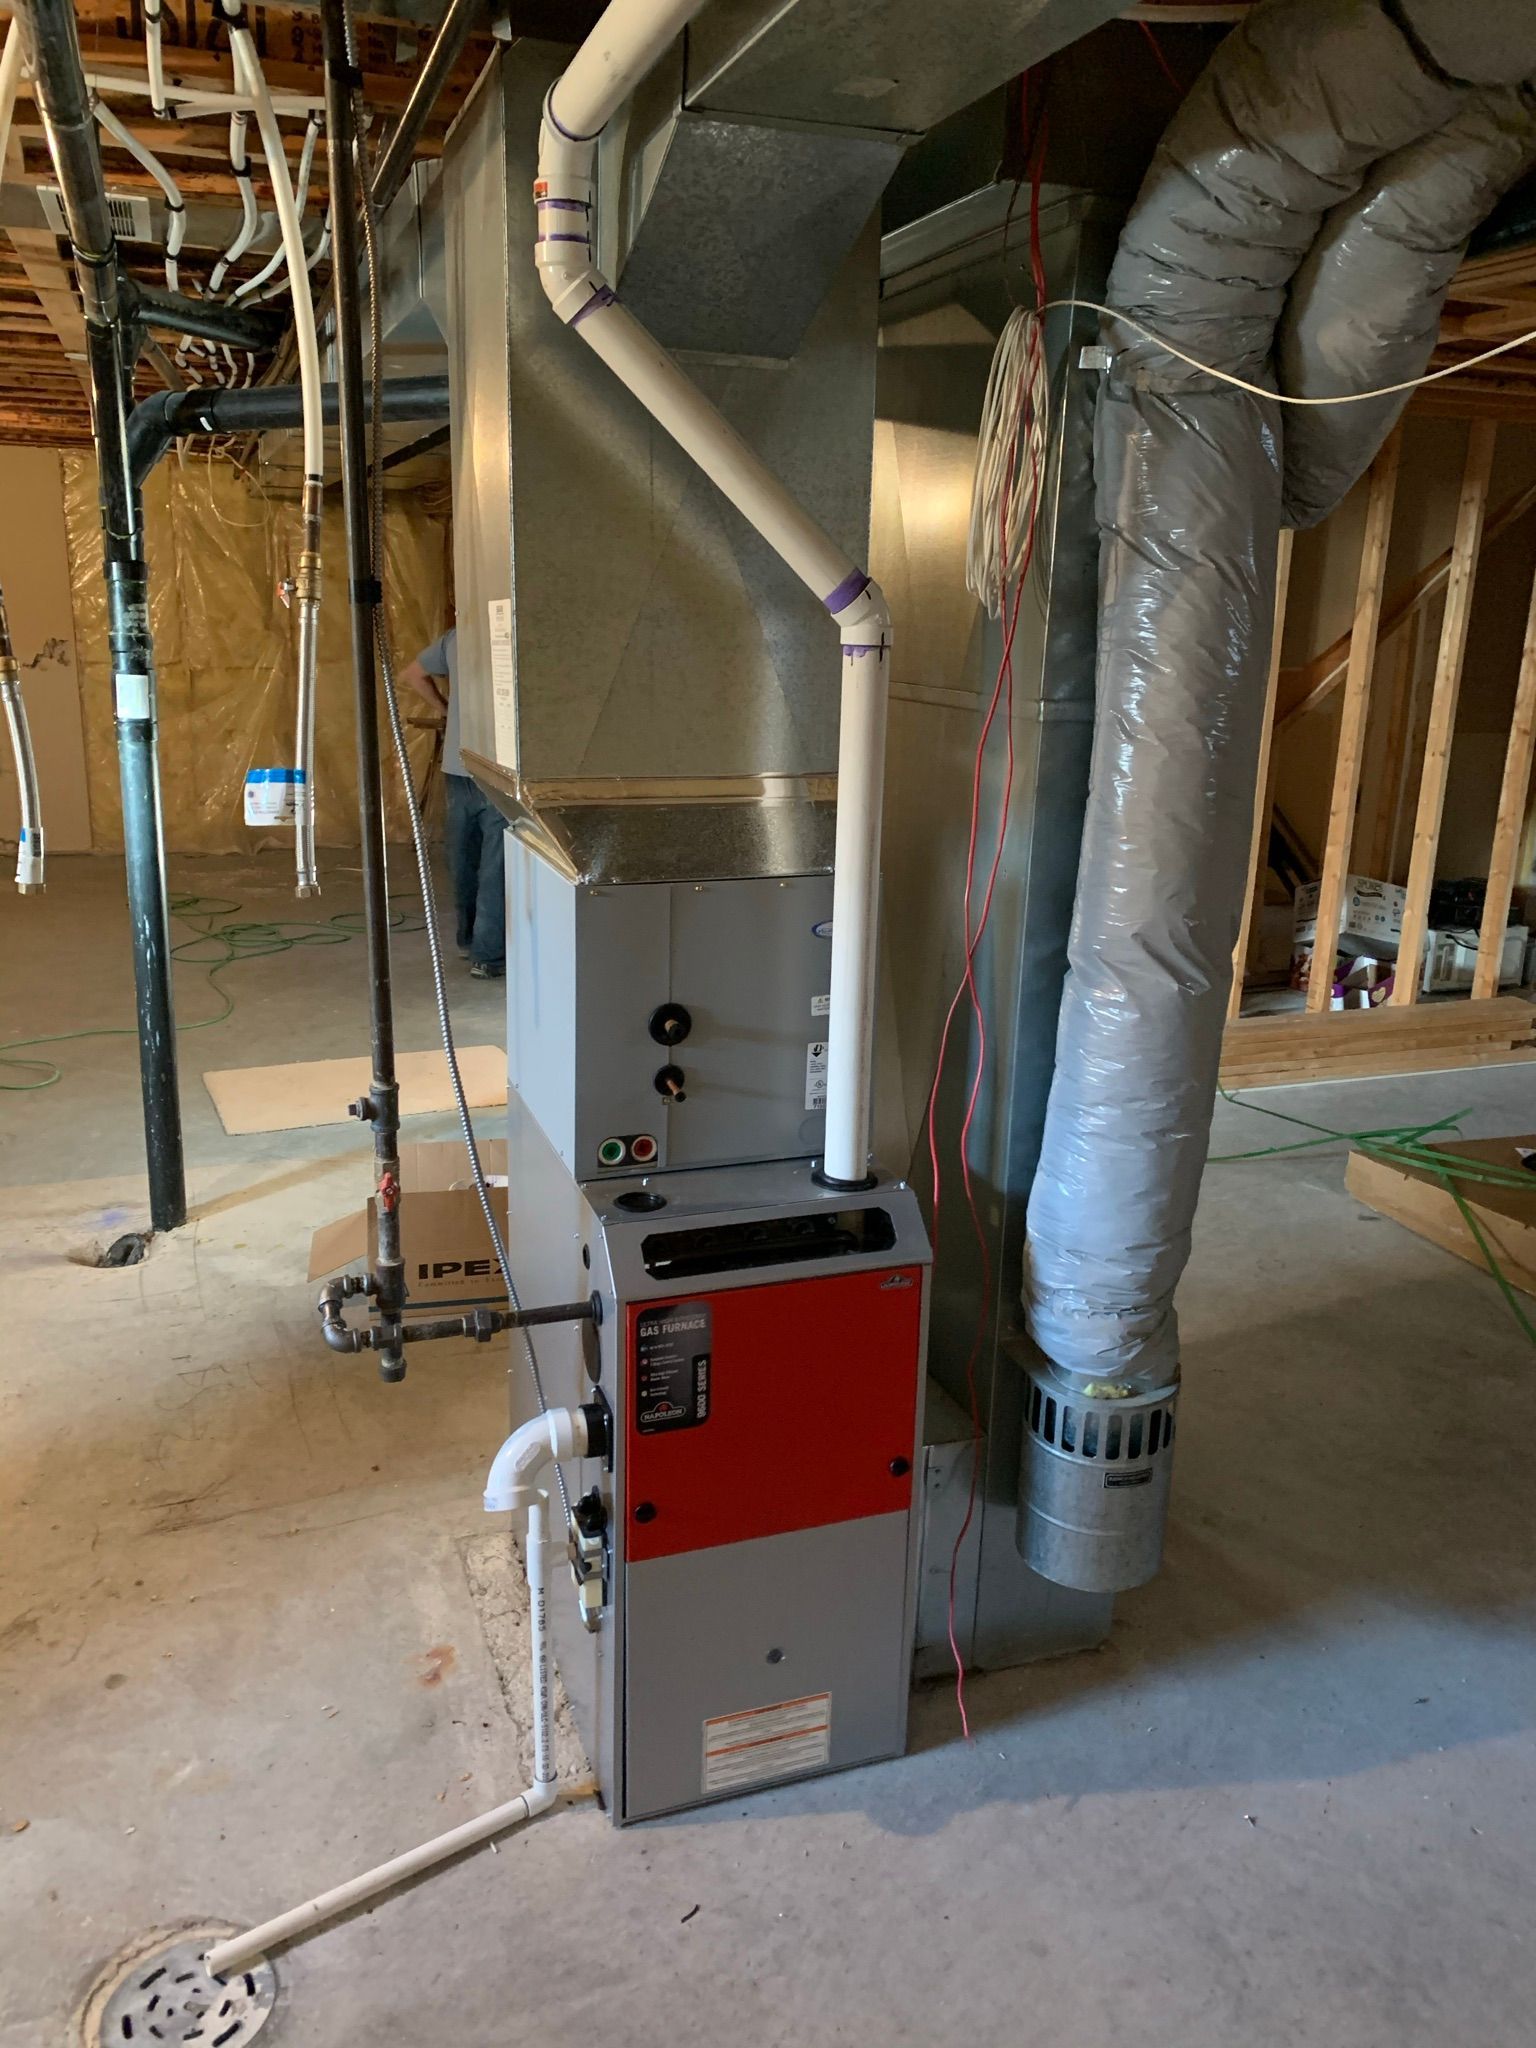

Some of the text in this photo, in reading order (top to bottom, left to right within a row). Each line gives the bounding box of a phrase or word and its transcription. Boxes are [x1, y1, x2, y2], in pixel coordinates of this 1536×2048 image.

[640, 1319, 706, 1337] GAS FURNACE
[697, 1360, 707, 1392] SERIES
[644, 1408, 683, 1420] NAPOLEON
